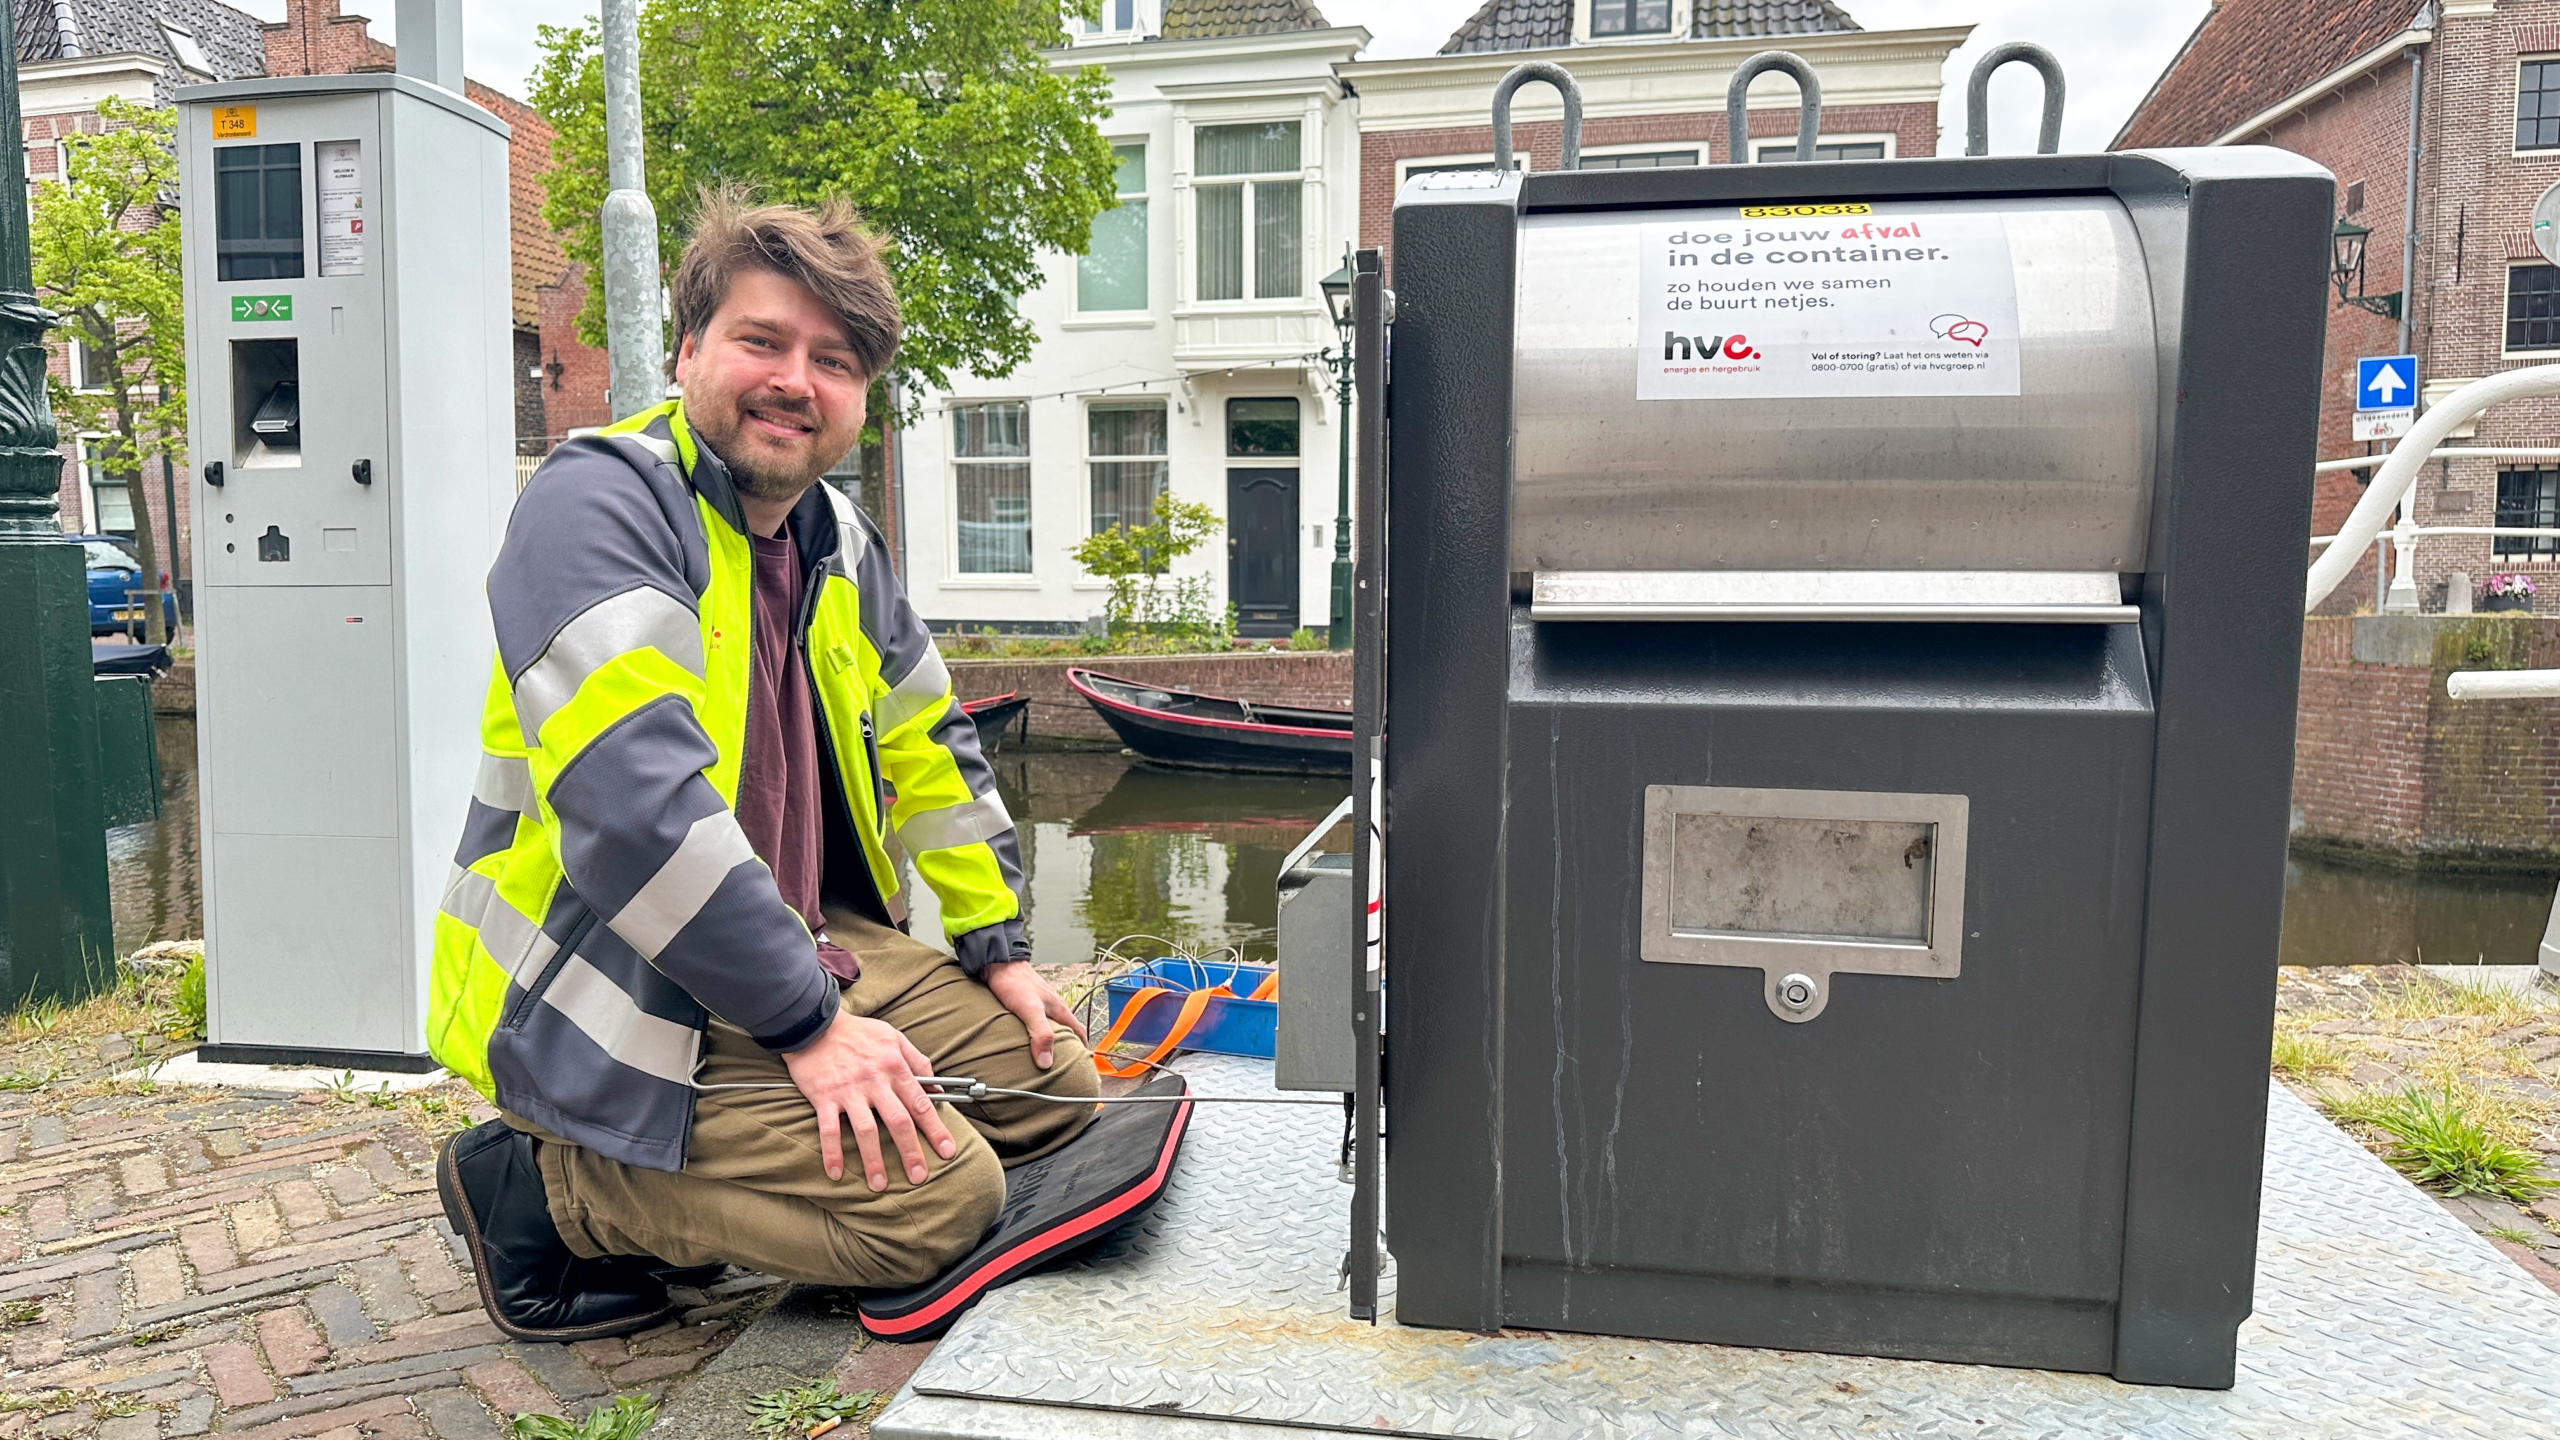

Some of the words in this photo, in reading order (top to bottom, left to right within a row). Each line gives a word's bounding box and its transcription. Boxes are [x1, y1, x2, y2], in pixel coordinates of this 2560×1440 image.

[220, 120, 227, 130] T
[228, 119, 245, 130] 348
[1743, 205, 1868, 218] 83038
[1668, 231, 1733, 245] doe
[1742, 229, 1830, 247] jouw
[1841, 222, 1921, 240] afval
[1669, 250, 1699, 266] in
[1710, 248, 1755, 266] de
[1766, 244, 1949, 265] container.
[1667, 282, 1691, 293] zo
[1698, 278, 1776, 293] houden
[1783, 280, 1815, 290] we
[1821, 278, 1892, 290] samen
[1667, 297, 1693, 311] de
[1700, 295, 1758, 310] buurt
[1764, 293, 1836, 311] netjes.
[1664, 331, 1762, 361] hvc.
[1811, 352, 1827, 361] Vol
[1829, 352, 1840, 360] of
[1841, 351, 1881, 362] storing?
[1883, 352, 1904, 360] Laat
[1906, 351, 1918, 360] het
[1943, 352, 1973, 360] weten
[1974, 351, 1989, 359] via
[1663, 366, 1697, 374] energie
[1712, 365, 1761, 374] hergebruik
[1811, 363, 1864, 372] 0800-0700
[1866, 362, 1899, 372] (gratis)
[1901, 362, 1911, 370] of
[1913, 362, 1927, 370] via
[1929, 362, 1986, 372] hvcgroep.nl
[2355, 411, 2410, 422] uitgezonderd
